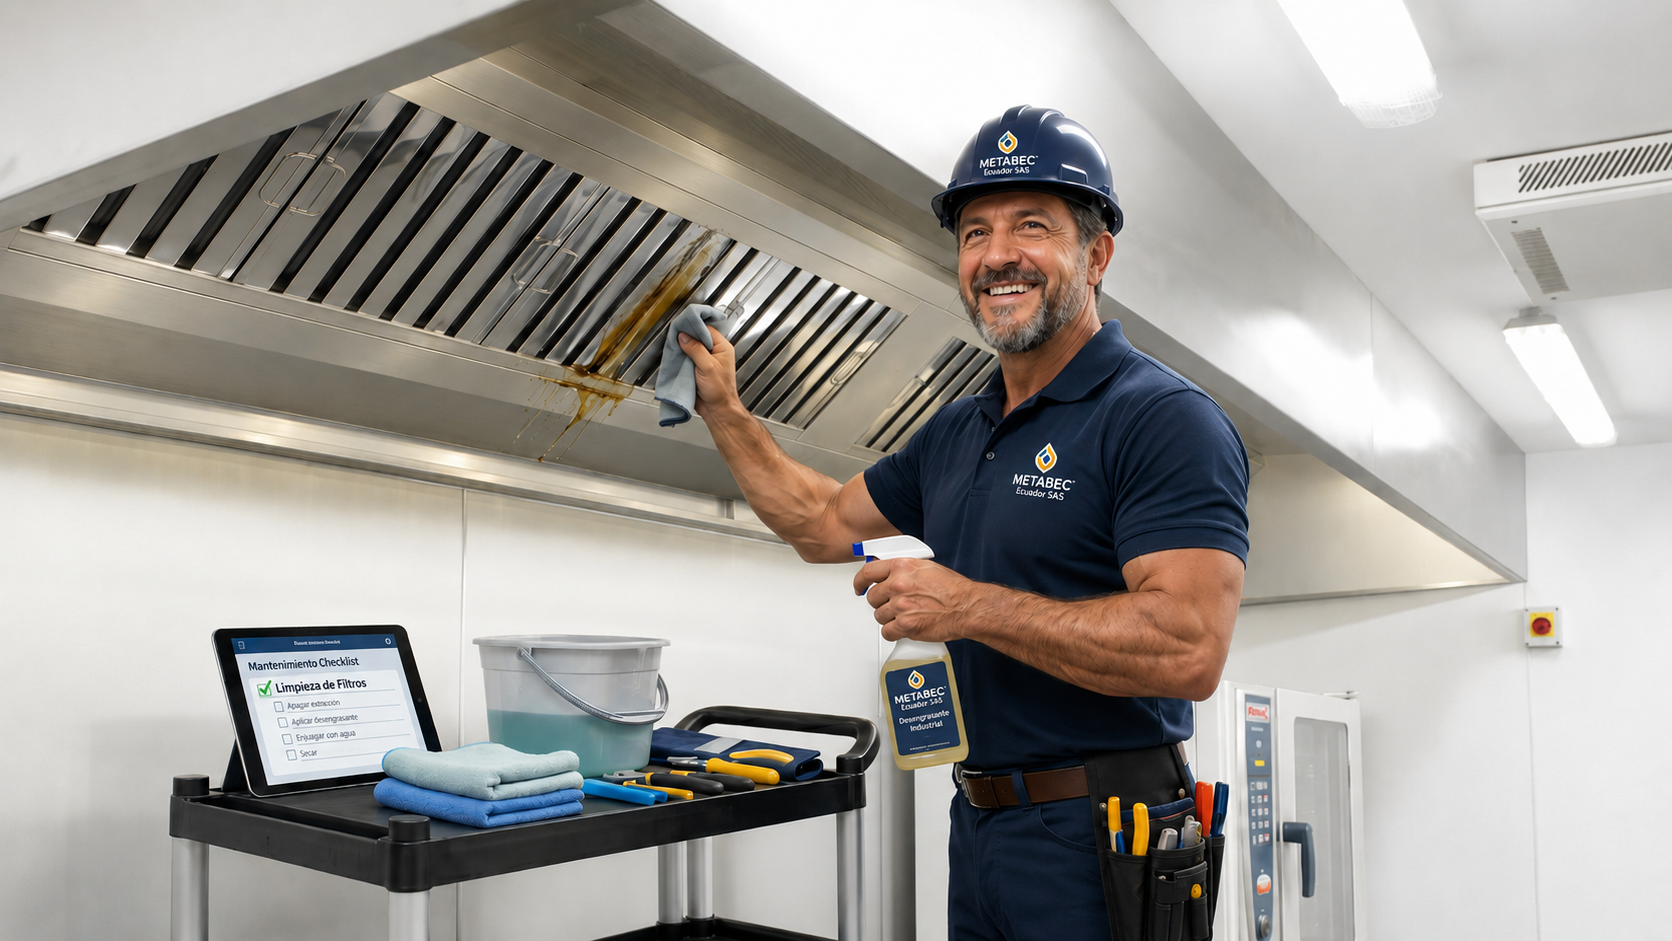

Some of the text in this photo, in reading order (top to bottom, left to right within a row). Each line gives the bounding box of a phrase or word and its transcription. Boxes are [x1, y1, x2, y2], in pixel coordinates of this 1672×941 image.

[1014, 166, 1030, 174] SAS
[1016, 486, 1065, 501] Ecuador SAS
[248, 656, 360, 671] Mantenimiento Checklist
[275, 678, 367, 694] Limpieza de Filtros
[287, 701, 310, 711] Apagar
[291, 716, 313, 727] Aplicar
[296, 732, 325, 743] Enjuagar
[339, 730, 356, 740] agua
[300, 749, 318, 758] Secar
